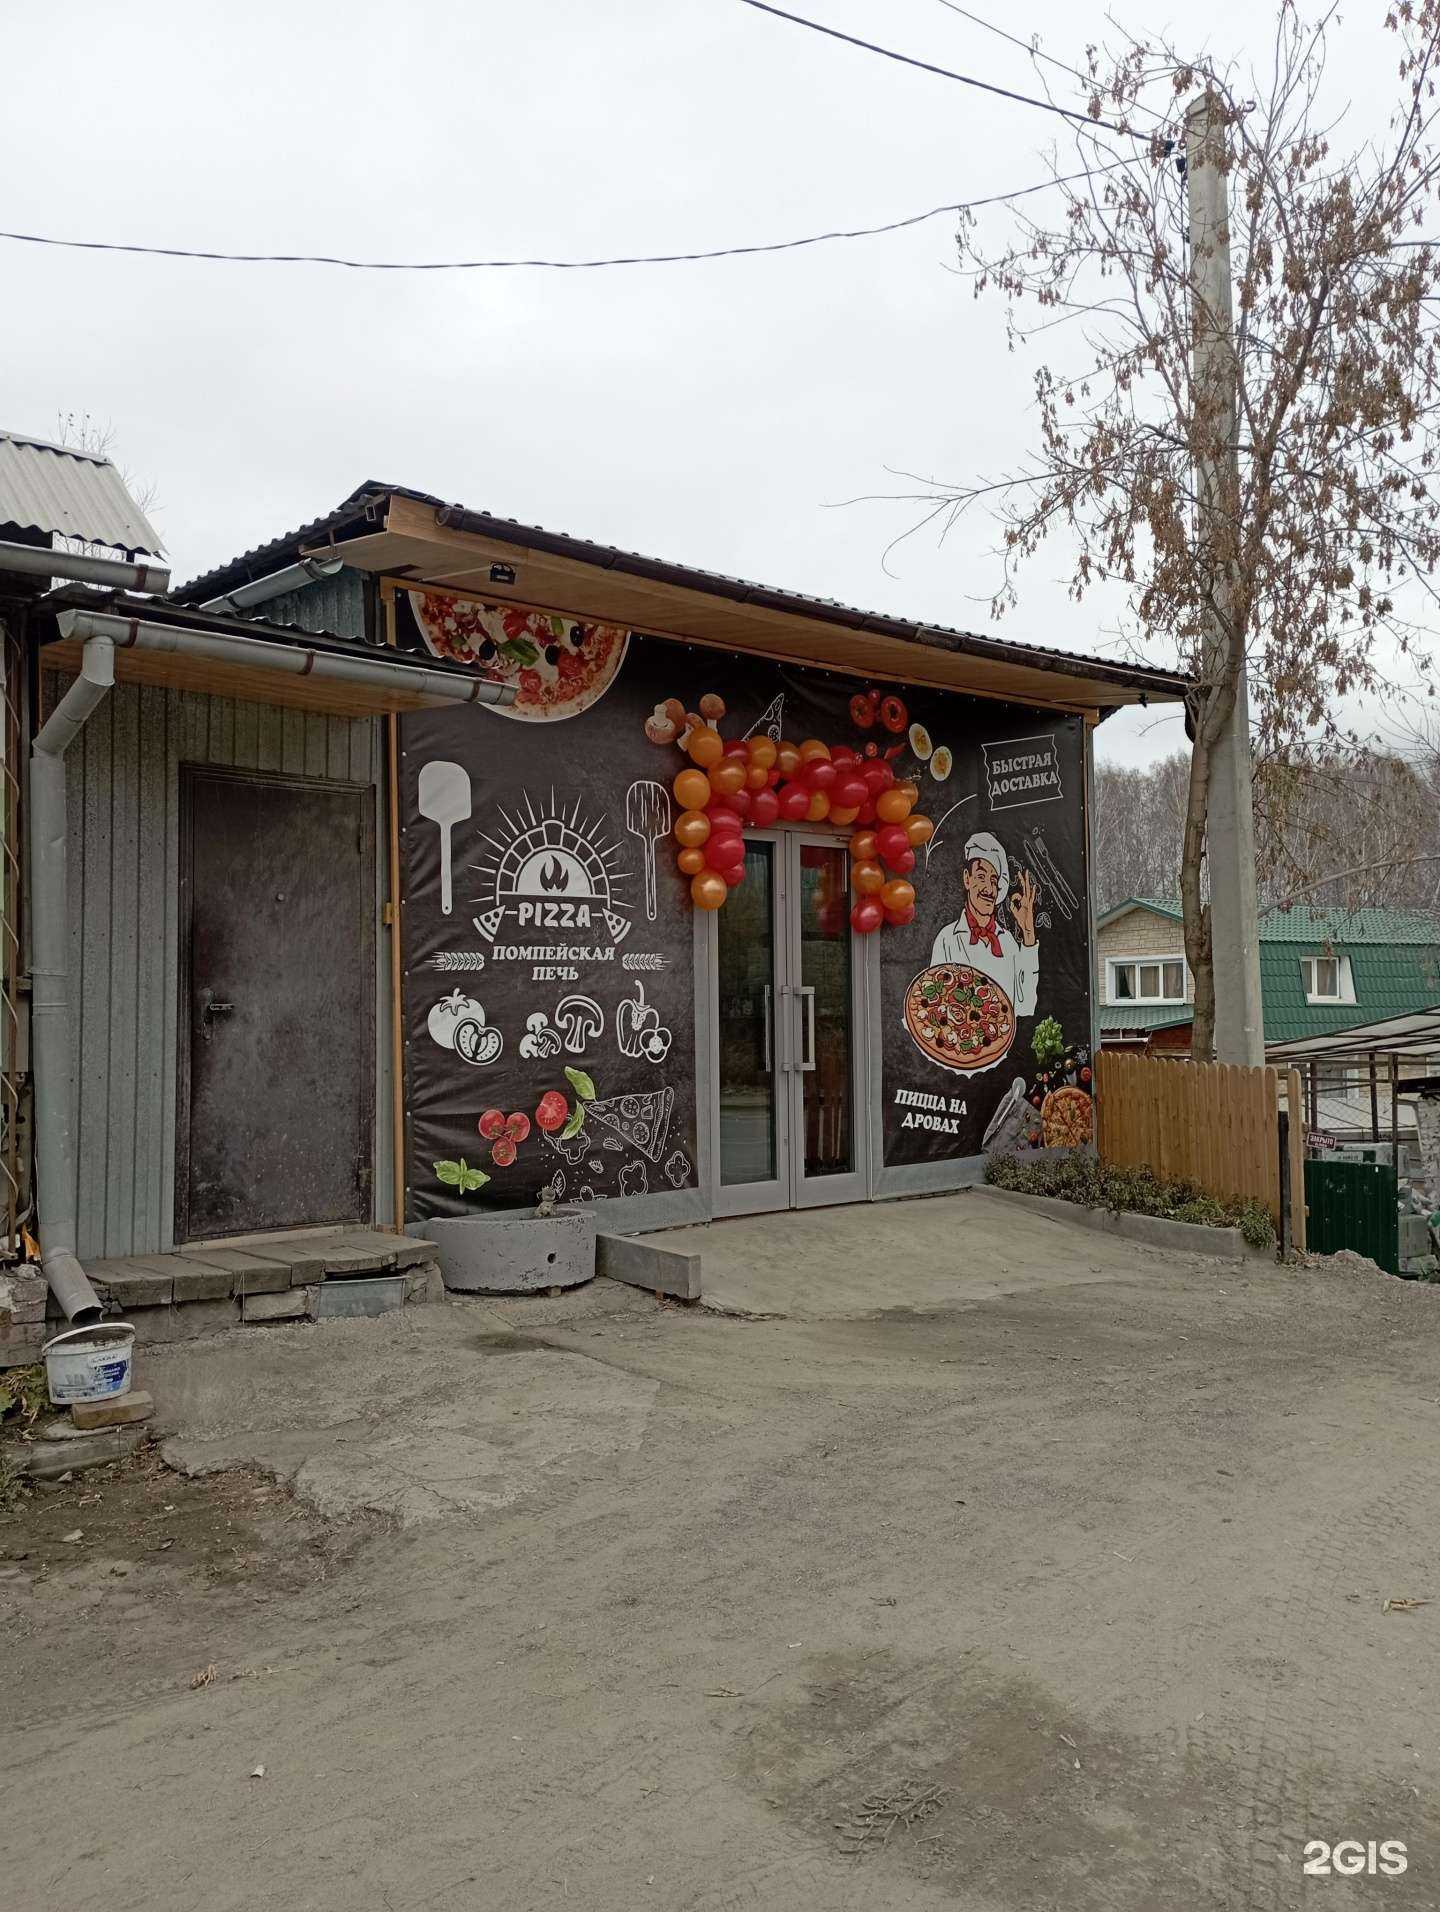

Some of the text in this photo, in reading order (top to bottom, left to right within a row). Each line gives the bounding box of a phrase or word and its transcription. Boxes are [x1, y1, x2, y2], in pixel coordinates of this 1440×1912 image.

[992, 752, 1051, 775] БЫСТРАЯ
[991, 771, 1058, 797] ДОСТАВКА
[519, 902, 591, 927] PIZZA
[492, 942, 615, 961] ПОМПЕЙСКАЯ
[532, 966, 579, 981] ПЕЧЬ
[894, 1089, 968, 1115] ПИЦЦА НА
[901, 1112, 960, 1134] ДРОВАХ
